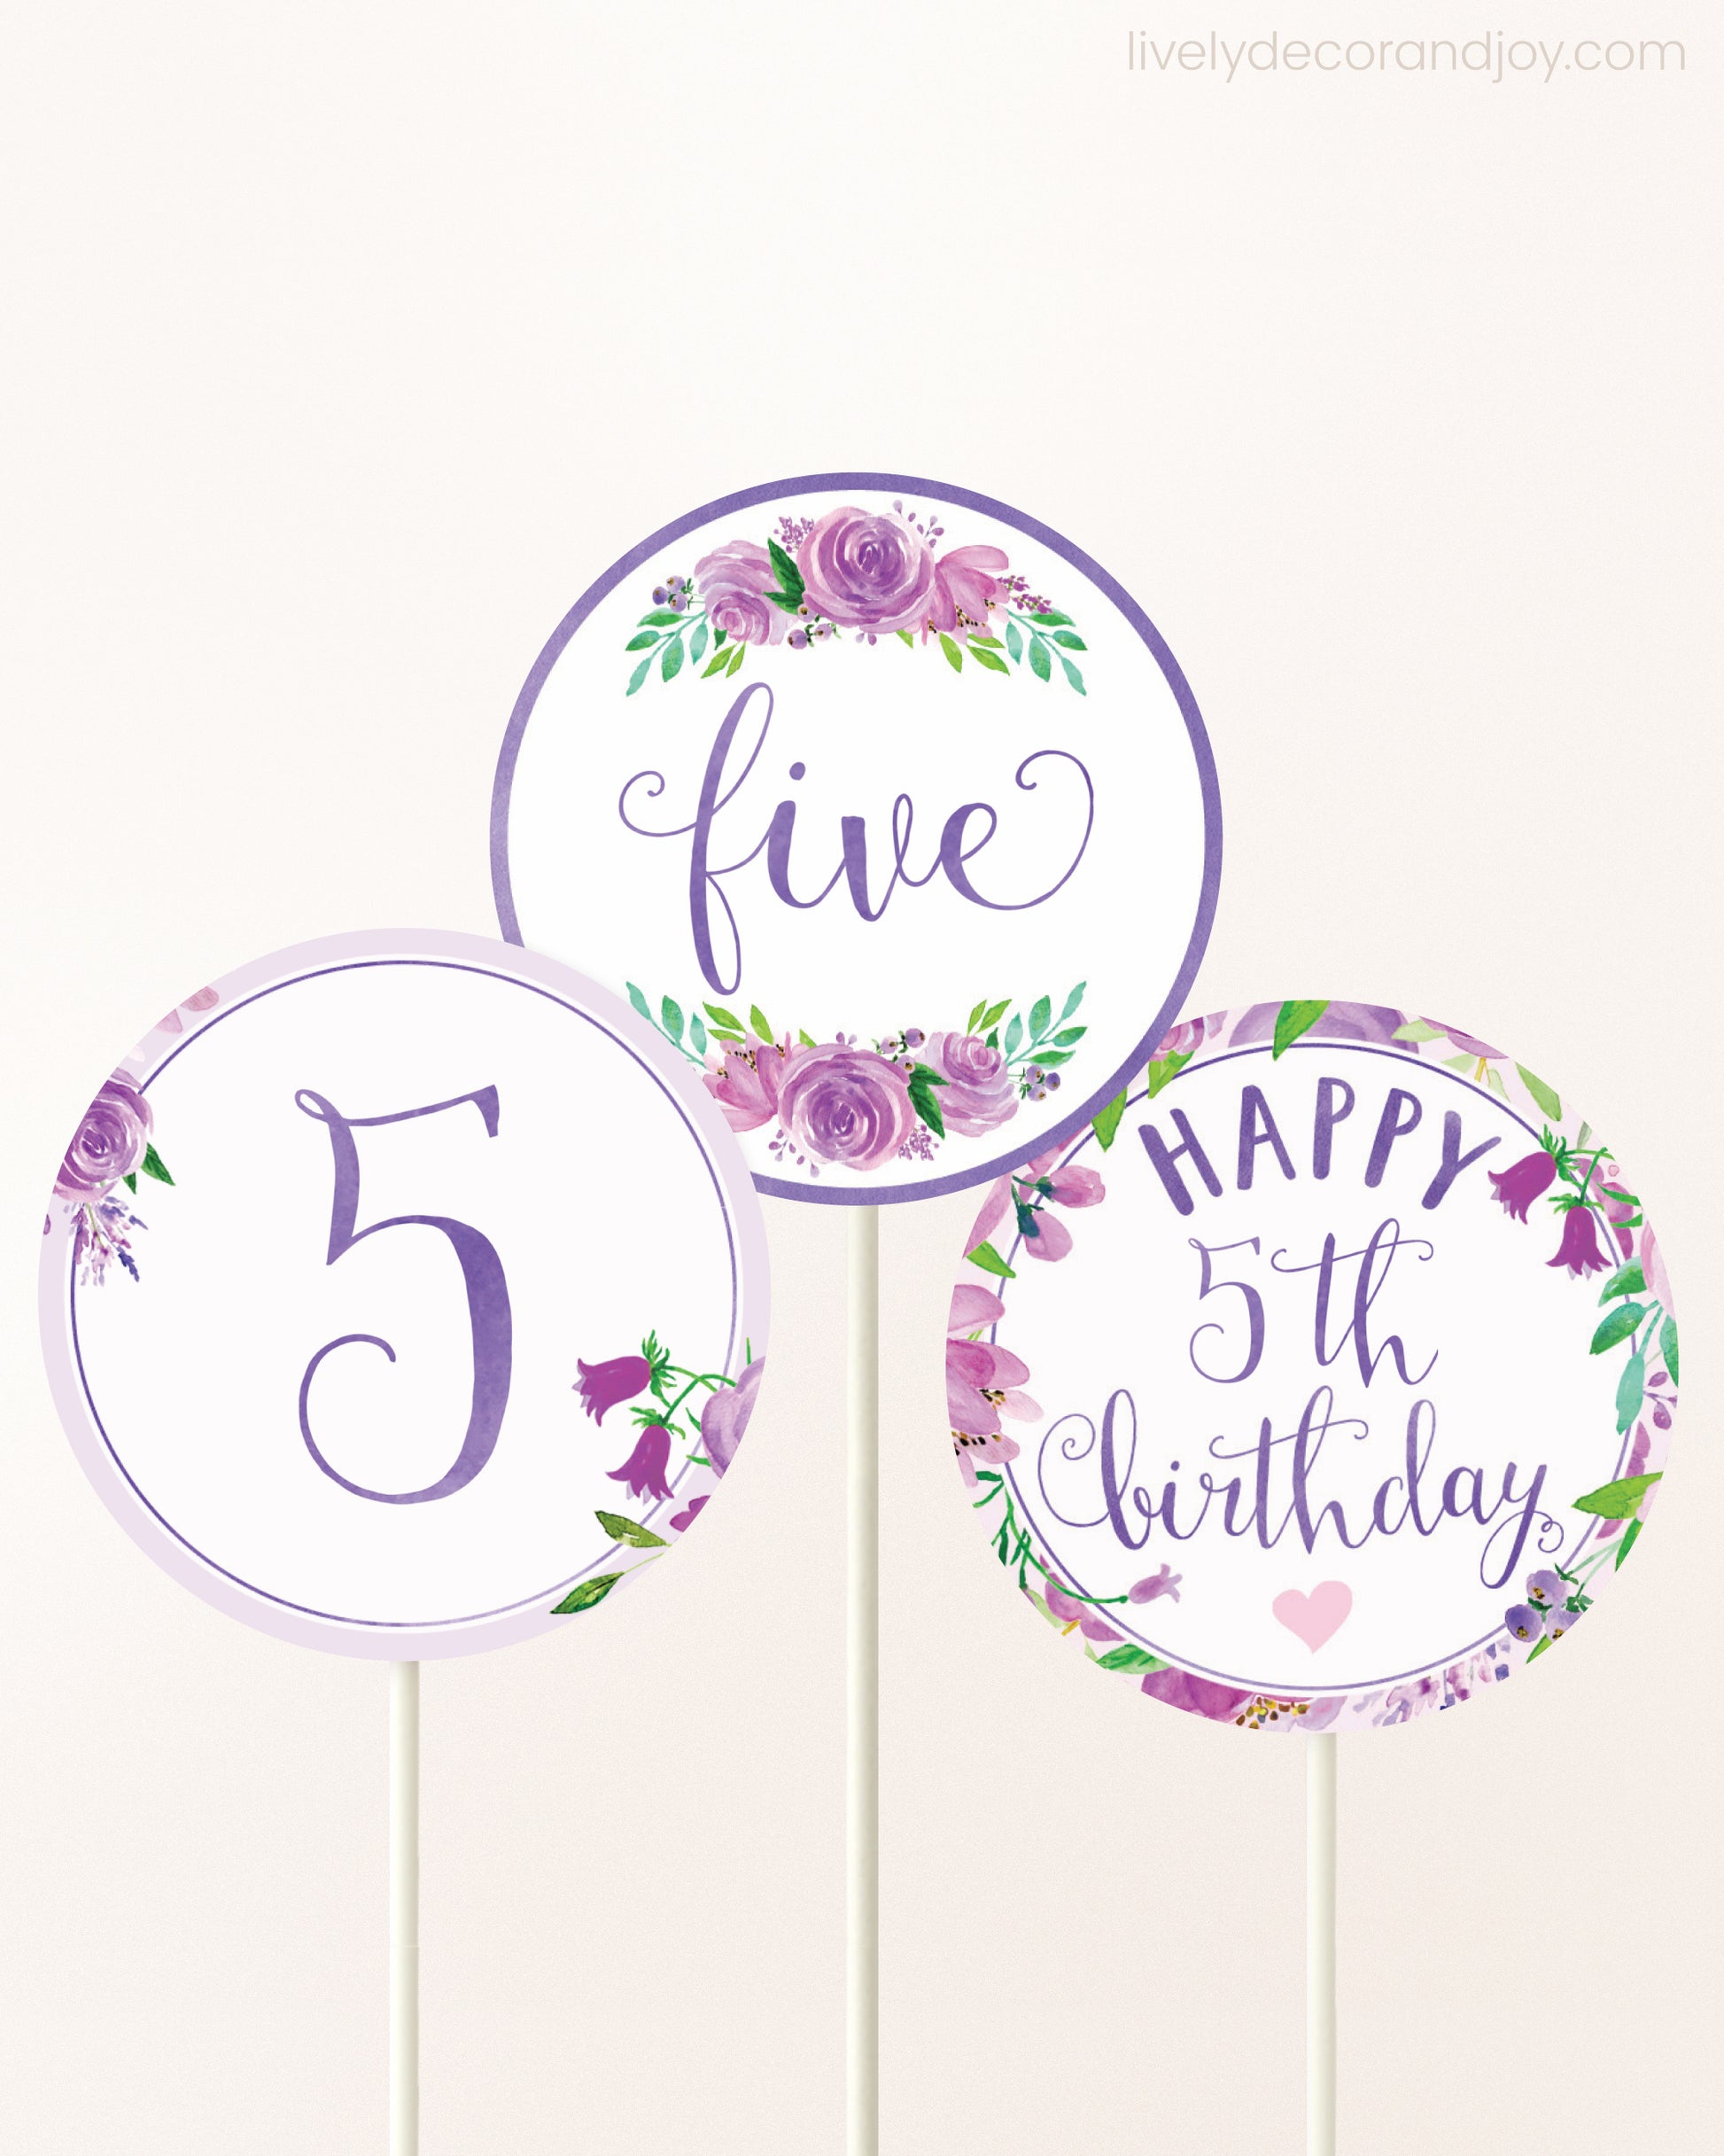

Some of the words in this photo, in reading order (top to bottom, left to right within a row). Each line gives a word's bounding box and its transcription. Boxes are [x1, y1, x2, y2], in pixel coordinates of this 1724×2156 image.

[618, 681, 1095, 996] five
[1137, 1076, 1503, 1217] HAPPY
[294, 1085, 513, 1506] 5
[1037, 1384, 1565, 1590] birthday
